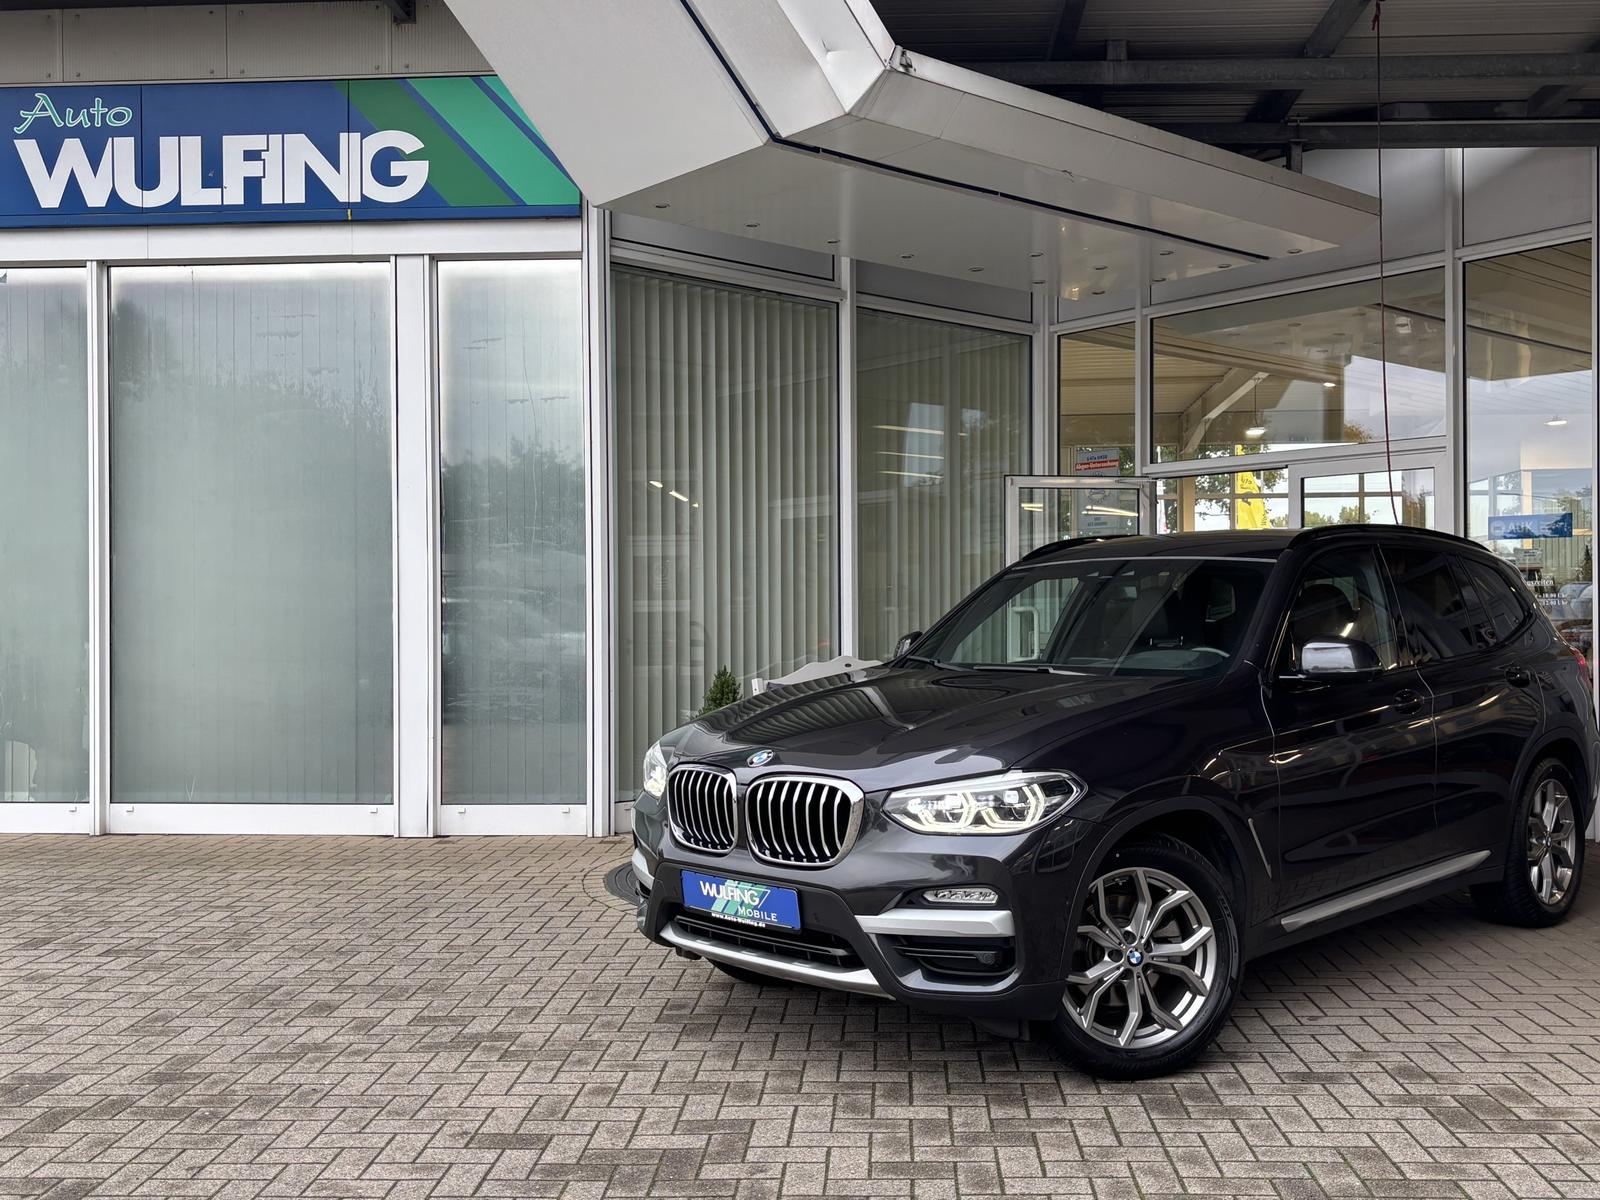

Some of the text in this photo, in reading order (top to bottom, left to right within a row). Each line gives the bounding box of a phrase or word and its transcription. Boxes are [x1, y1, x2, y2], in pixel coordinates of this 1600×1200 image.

[13, 92, 133, 134] Auto
[13, 129, 430, 209] WULFING
[699, 880, 760, 906] WULFING
[737, 905, 778, 922] MOBILE
